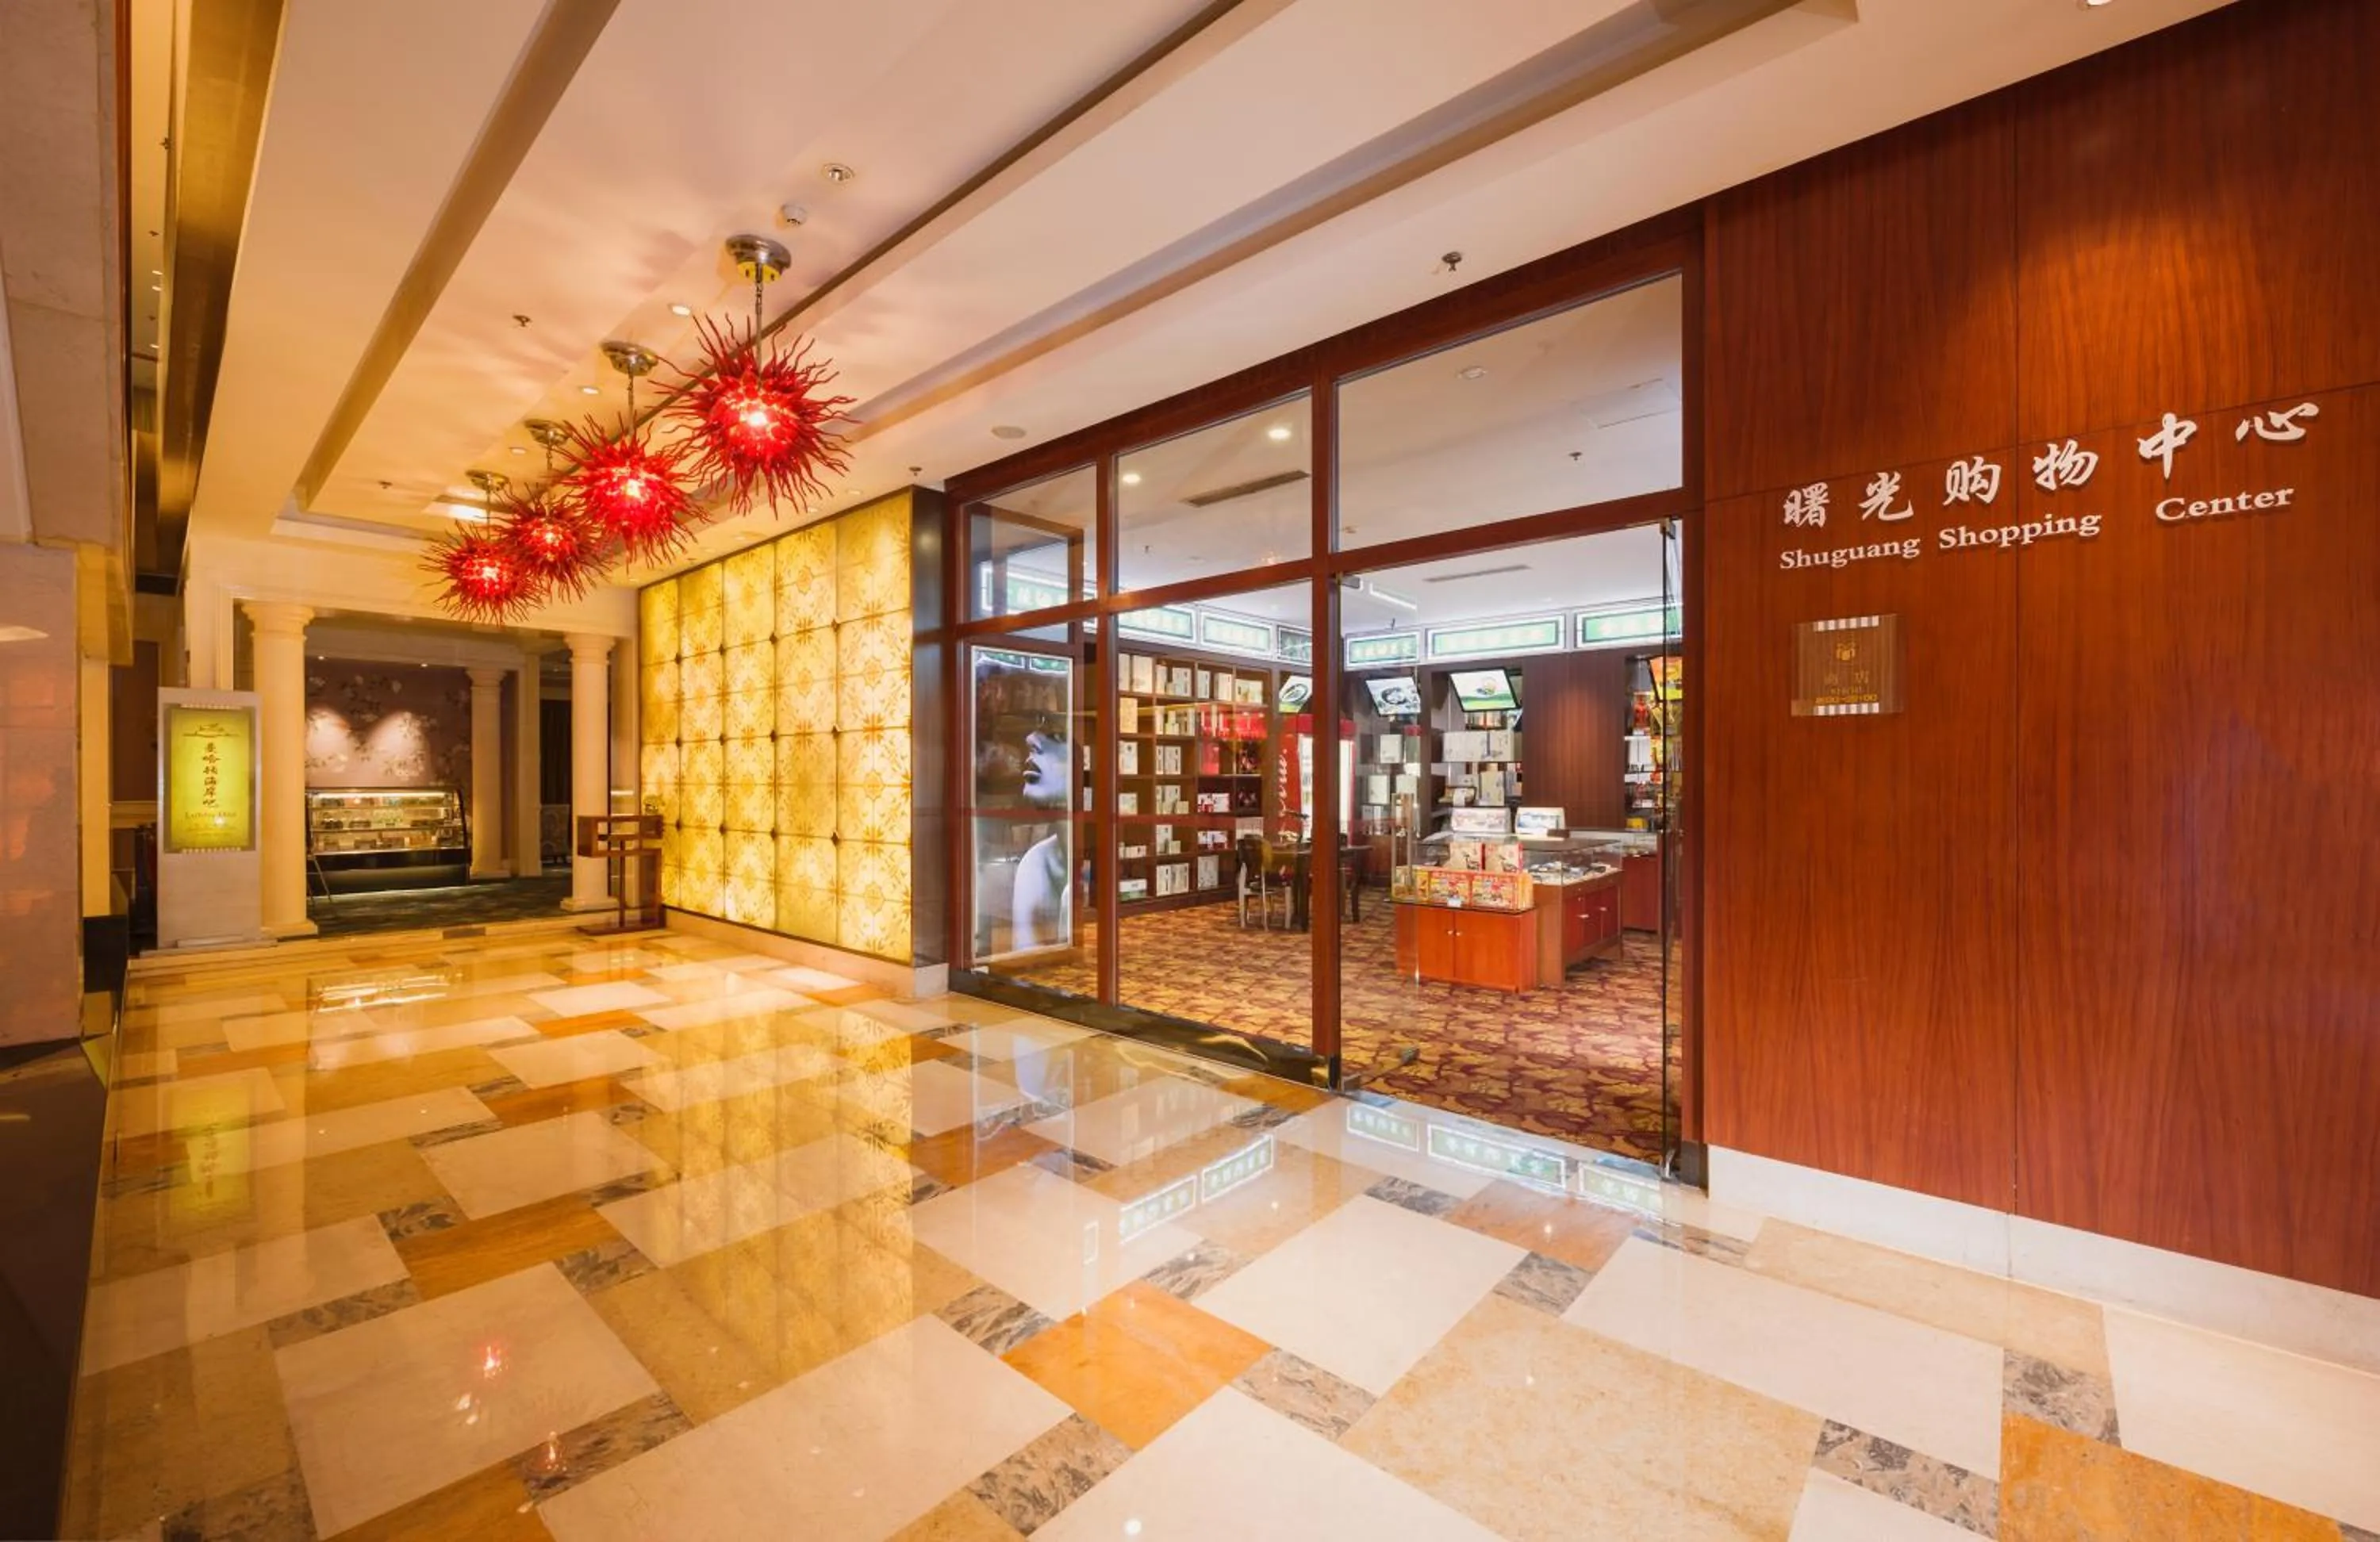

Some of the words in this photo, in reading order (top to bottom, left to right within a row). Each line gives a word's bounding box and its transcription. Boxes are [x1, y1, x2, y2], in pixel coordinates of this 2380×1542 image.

[1783, 402, 2320, 527] 曙光购物中心
[1780, 538, 1921, 569] Shuguang
[1939, 512, 2102, 549] Shopping
[2155, 488, 2294, 521] Center
